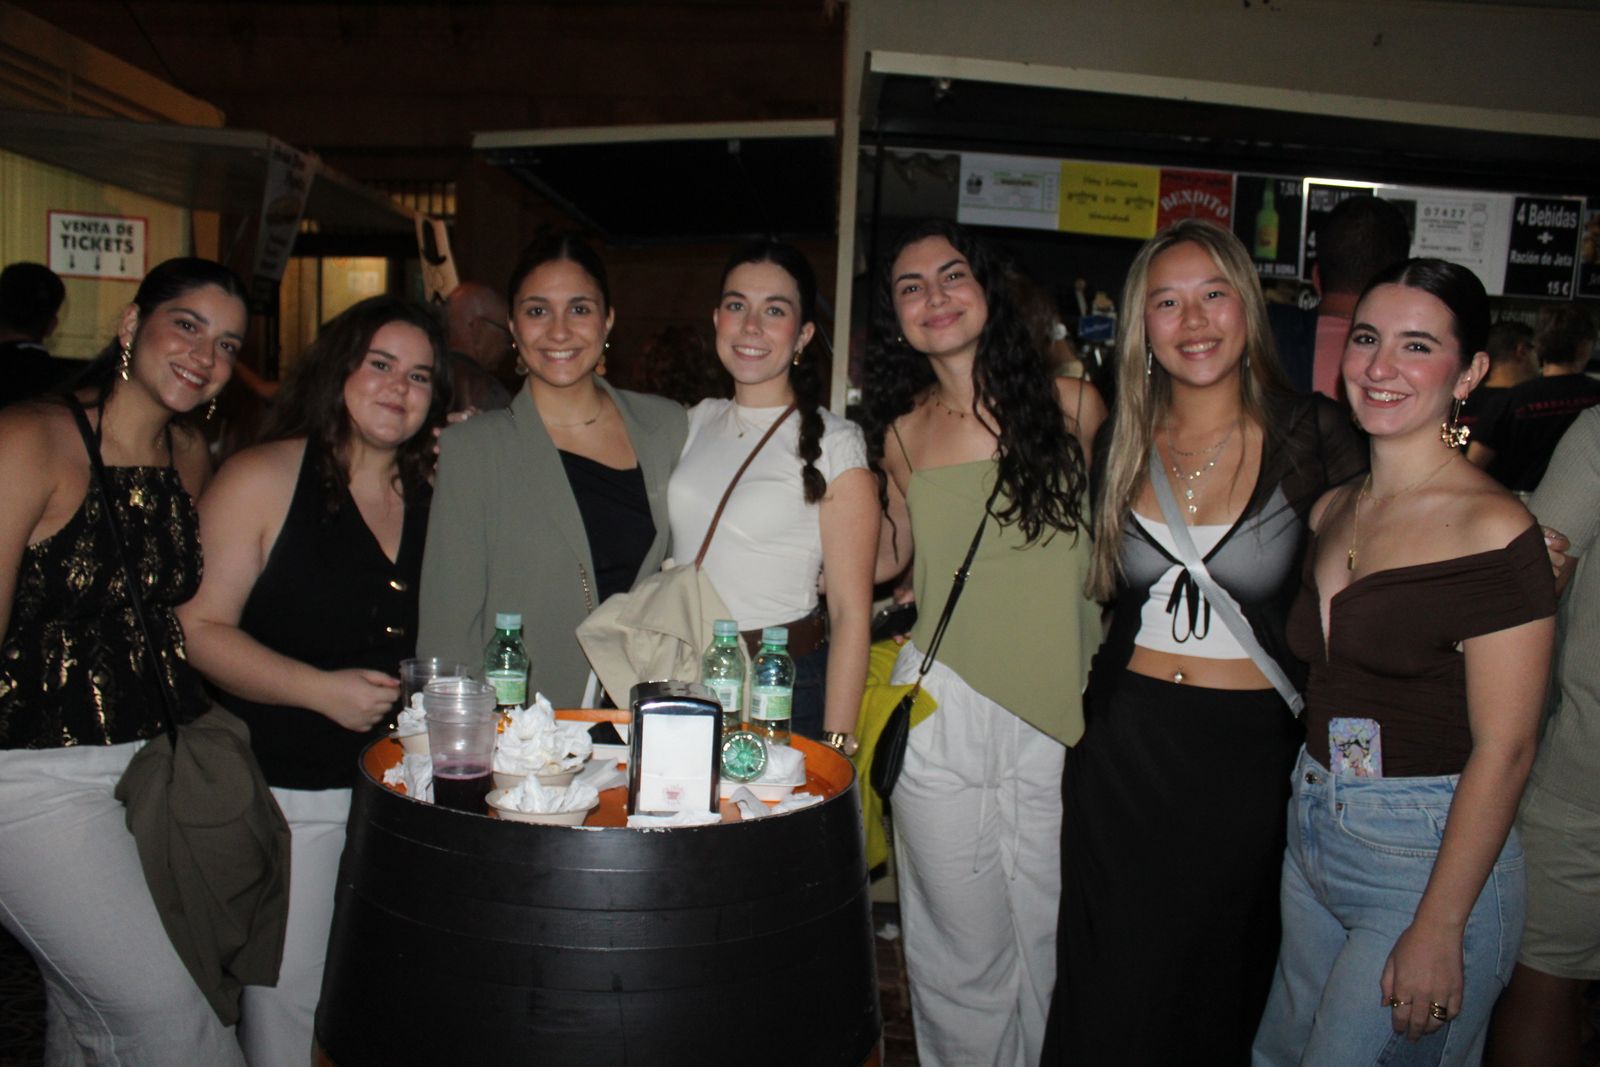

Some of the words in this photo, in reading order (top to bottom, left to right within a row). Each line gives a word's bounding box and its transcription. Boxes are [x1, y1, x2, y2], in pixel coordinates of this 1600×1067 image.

[1160, 189, 1229, 218] BENDITO
[1424, 206, 1466, 219] 07427
[1516, 202, 1527, 227] 4
[1528, 203, 1578, 230] Bebidas
[61, 220, 110, 234] VENTA
[116, 223, 134, 237] DE
[61, 234, 134, 254] TICKETS
[1509, 249, 1540, 265] Ración
[1541, 251, 1553, 267] de
[1553, 252, 1574, 268] Jeta
[1547, 281, 1561, 296] 15
[1561, 281, 1571, 297] €
